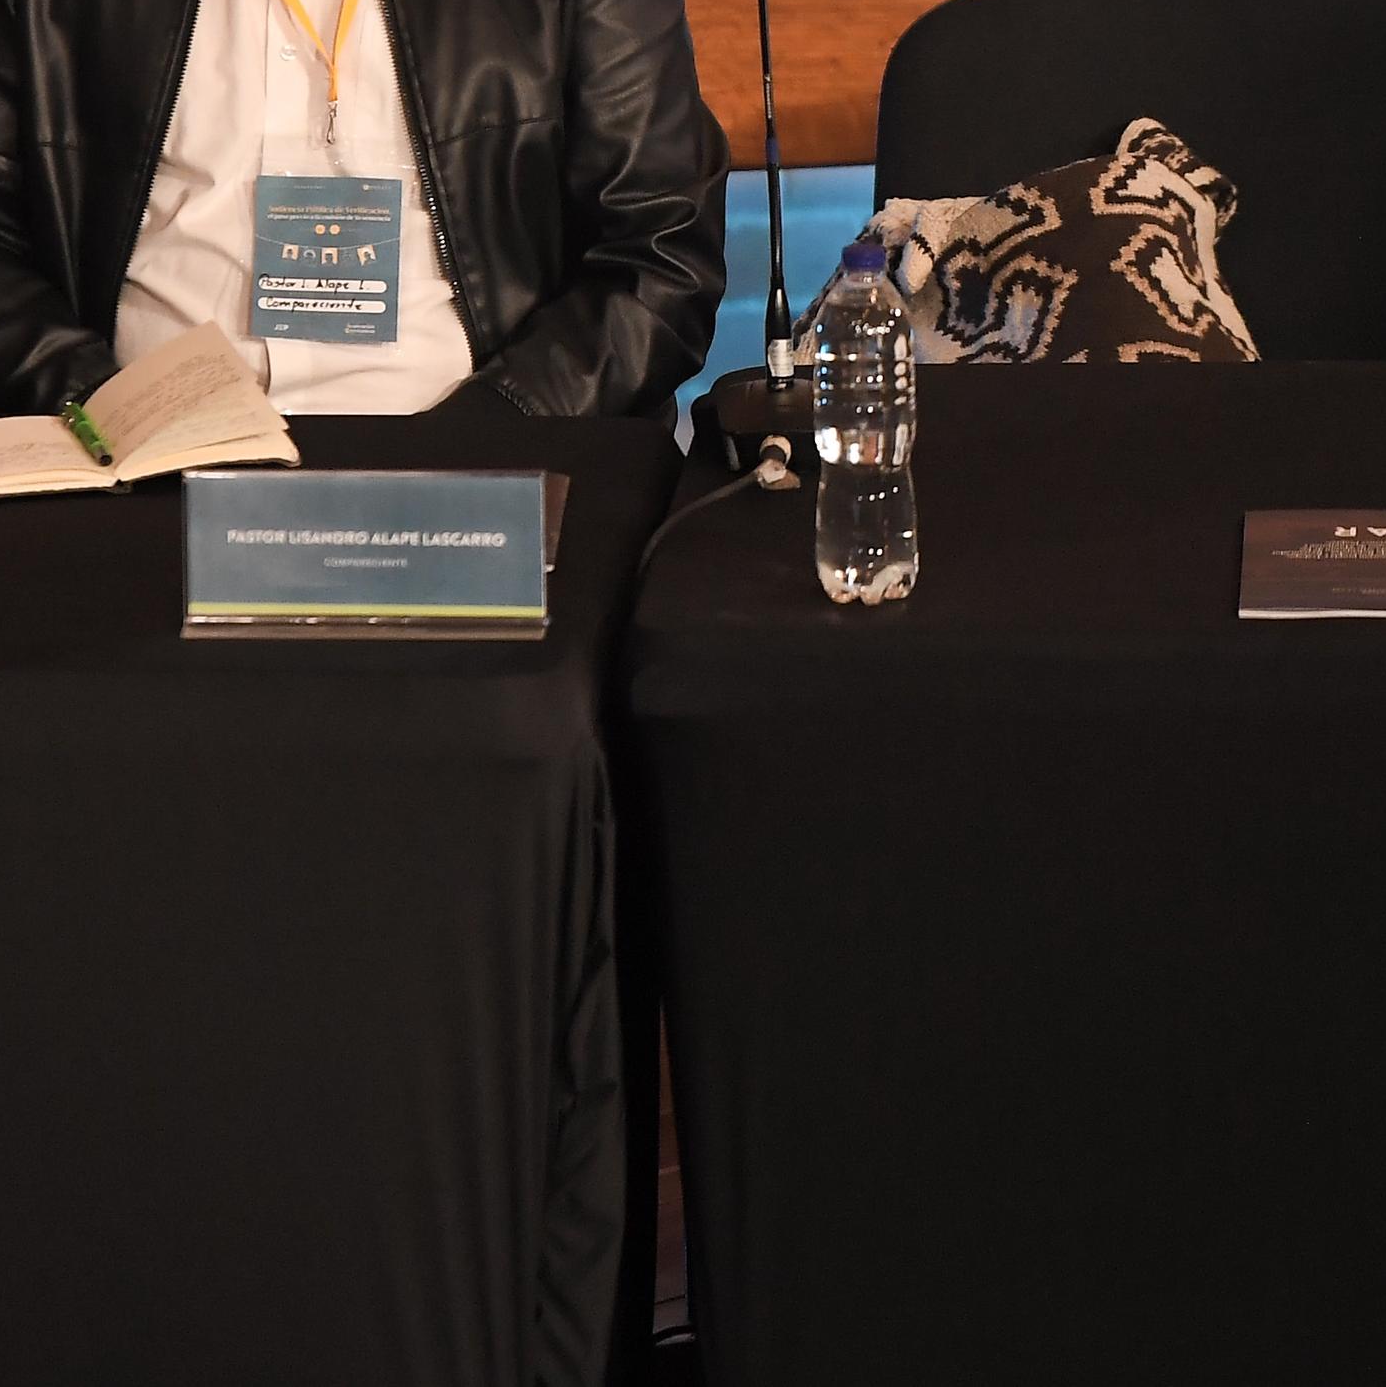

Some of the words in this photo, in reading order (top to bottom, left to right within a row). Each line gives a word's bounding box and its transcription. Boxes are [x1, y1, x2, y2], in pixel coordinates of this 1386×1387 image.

[227, 529, 286, 544] PASTOR
[289, 531, 369, 545] LISANDRO
[371, 531, 420, 547] ALAPE
[422, 532, 507, 548] LASCARRO
